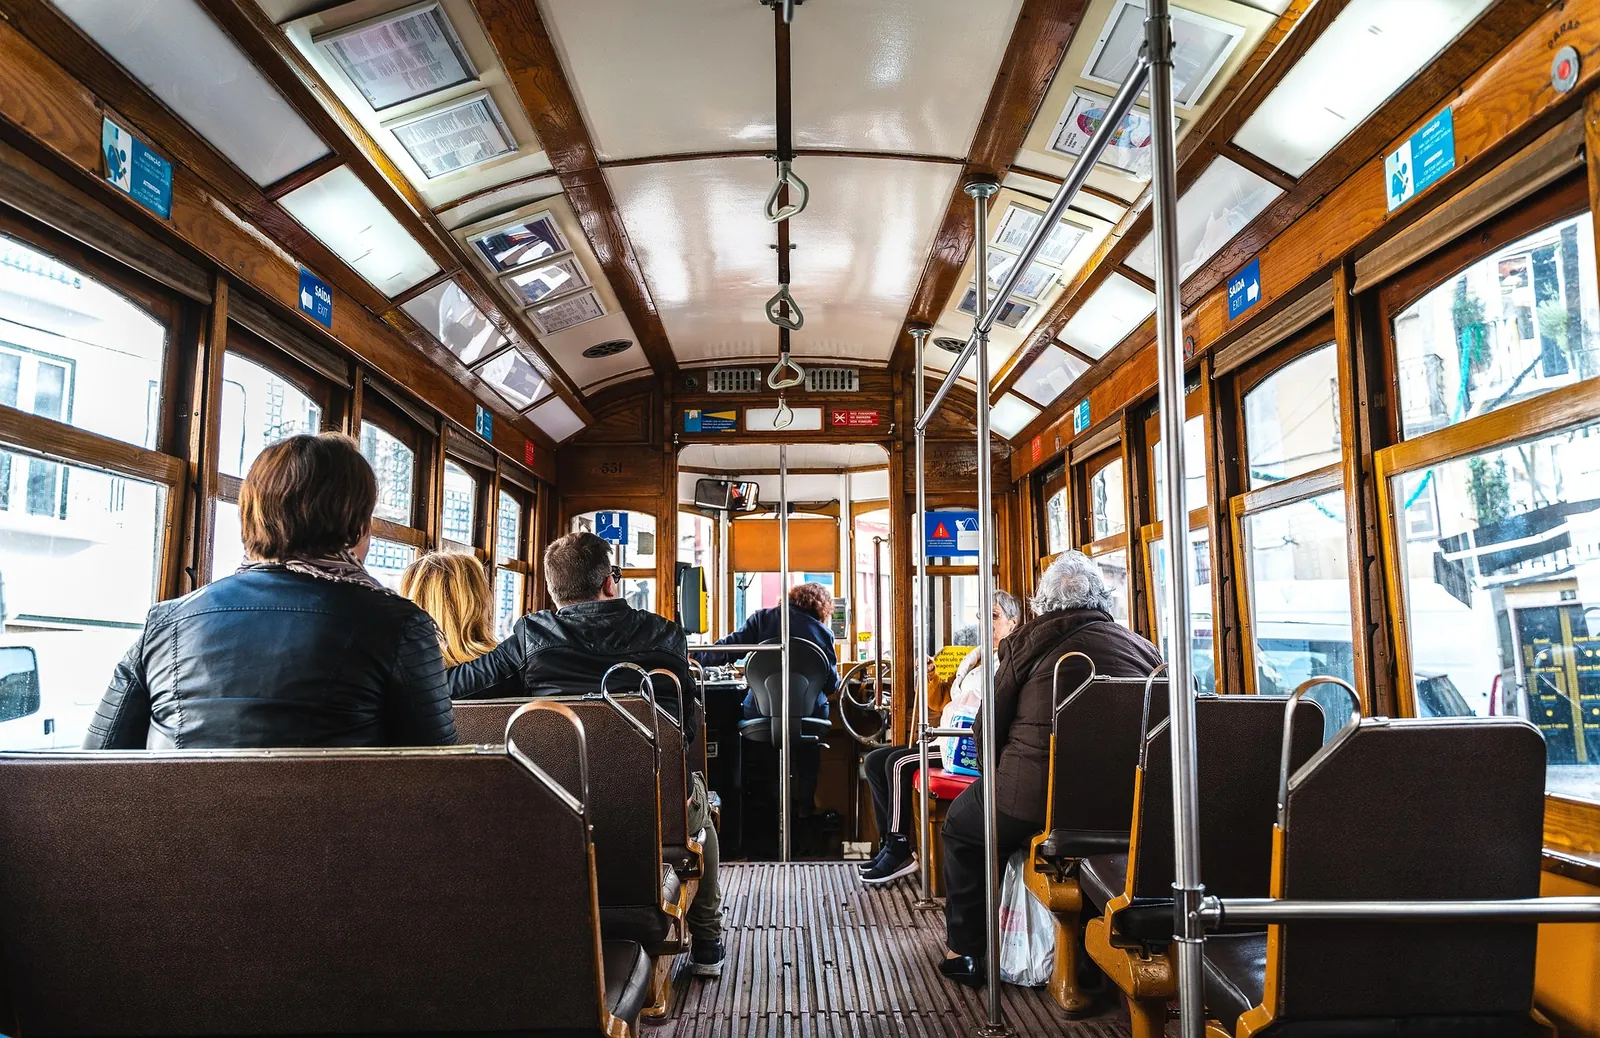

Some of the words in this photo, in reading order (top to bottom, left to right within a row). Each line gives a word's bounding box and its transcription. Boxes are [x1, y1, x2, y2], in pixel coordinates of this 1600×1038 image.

[315, 285, 331, 306] SAÍDA
[1229, 278, 1245, 298] SAÍDA
[317, 303, 328, 318] EXIT
[1233, 295, 1243, 311] EXIT
[601, 462, 622, 474] 551
